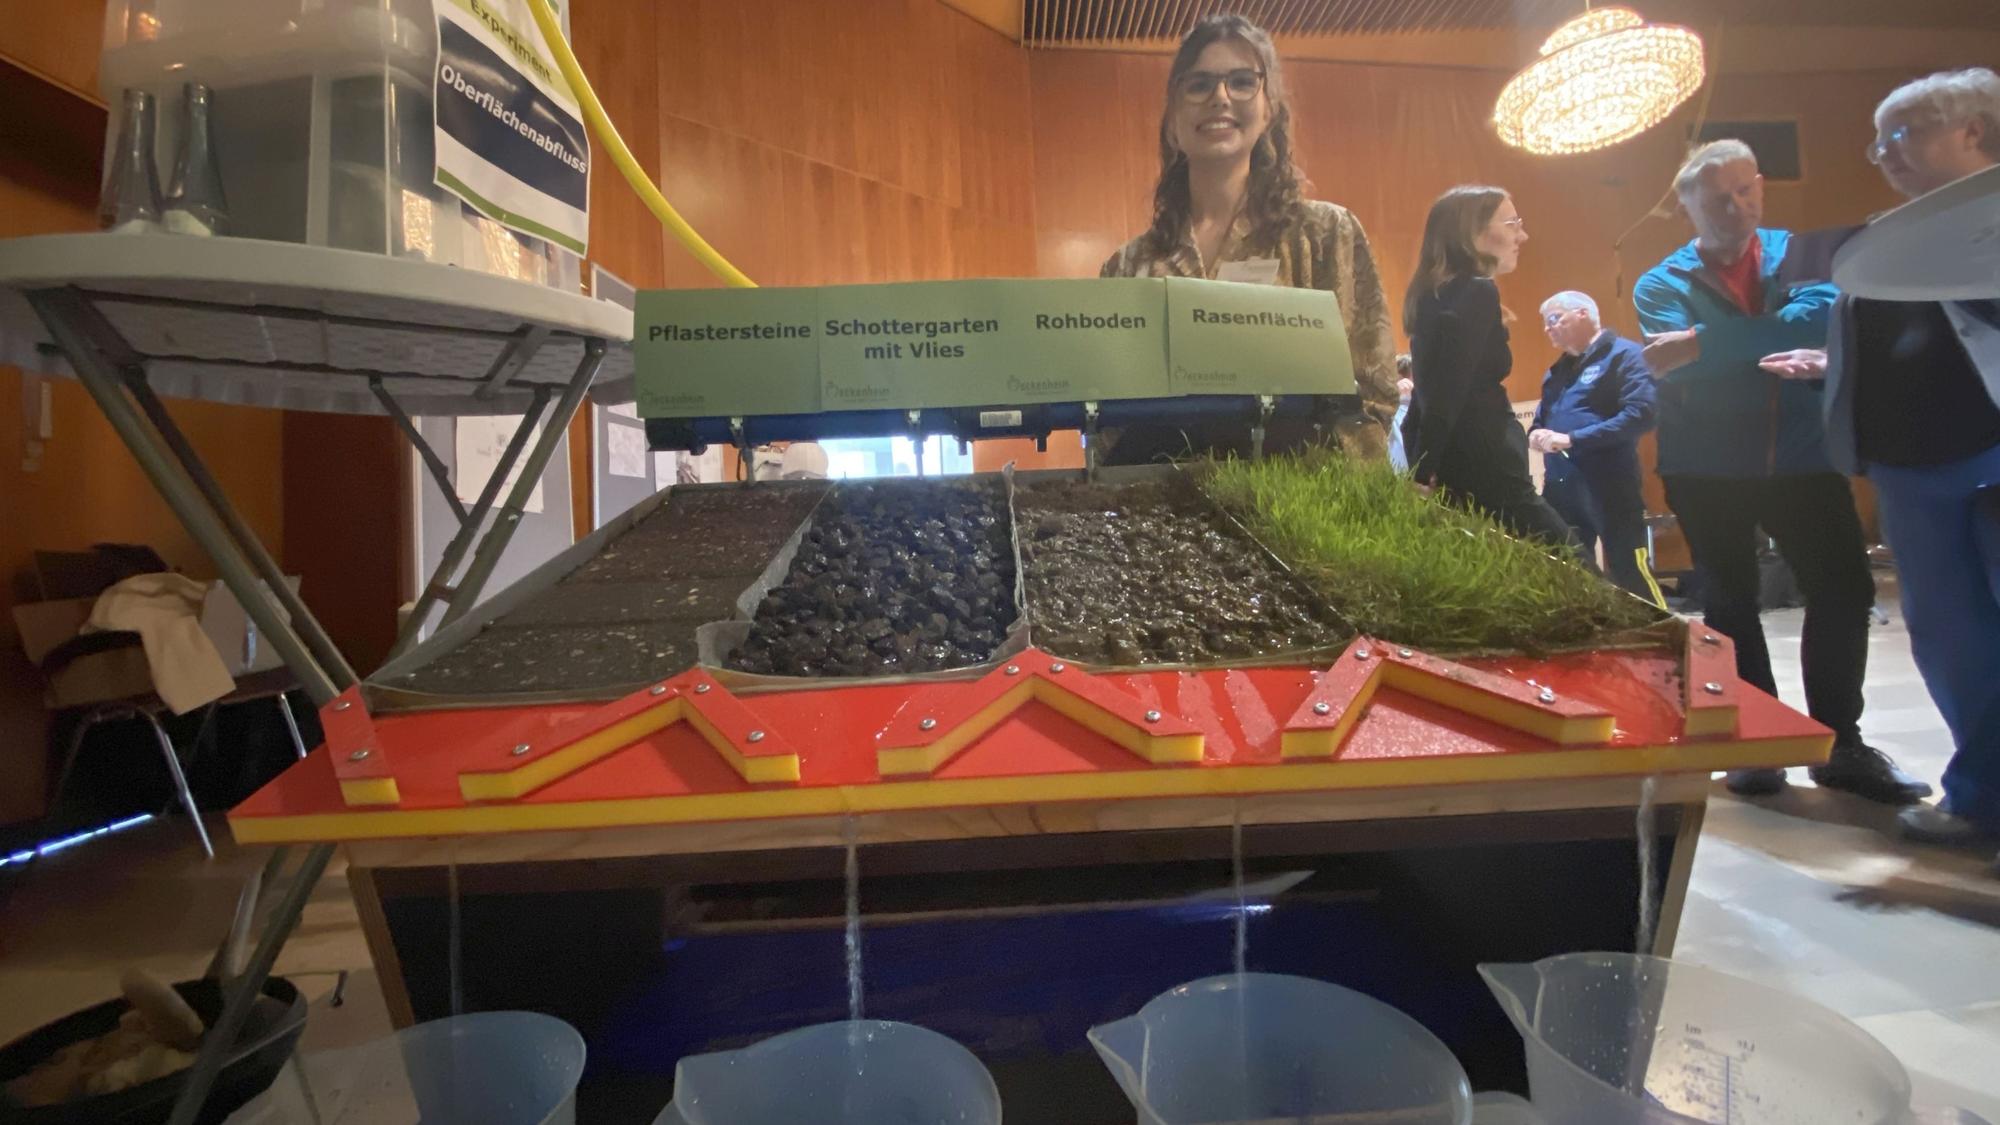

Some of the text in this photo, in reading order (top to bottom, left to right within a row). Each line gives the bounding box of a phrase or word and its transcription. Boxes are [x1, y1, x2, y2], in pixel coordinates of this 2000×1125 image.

[470, 0, 553, 84] Experiment
[441, 64, 587, 174] Oberflächenabfluss
[825, 318, 999, 338] Schottergarten
[1036, 313, 1146, 330] Rohboden
[1192, 308, 1325, 329] Rasenfläche
[648, 323, 811, 342] Pflastersteine
[864, 341, 965, 360] mit Vlies
